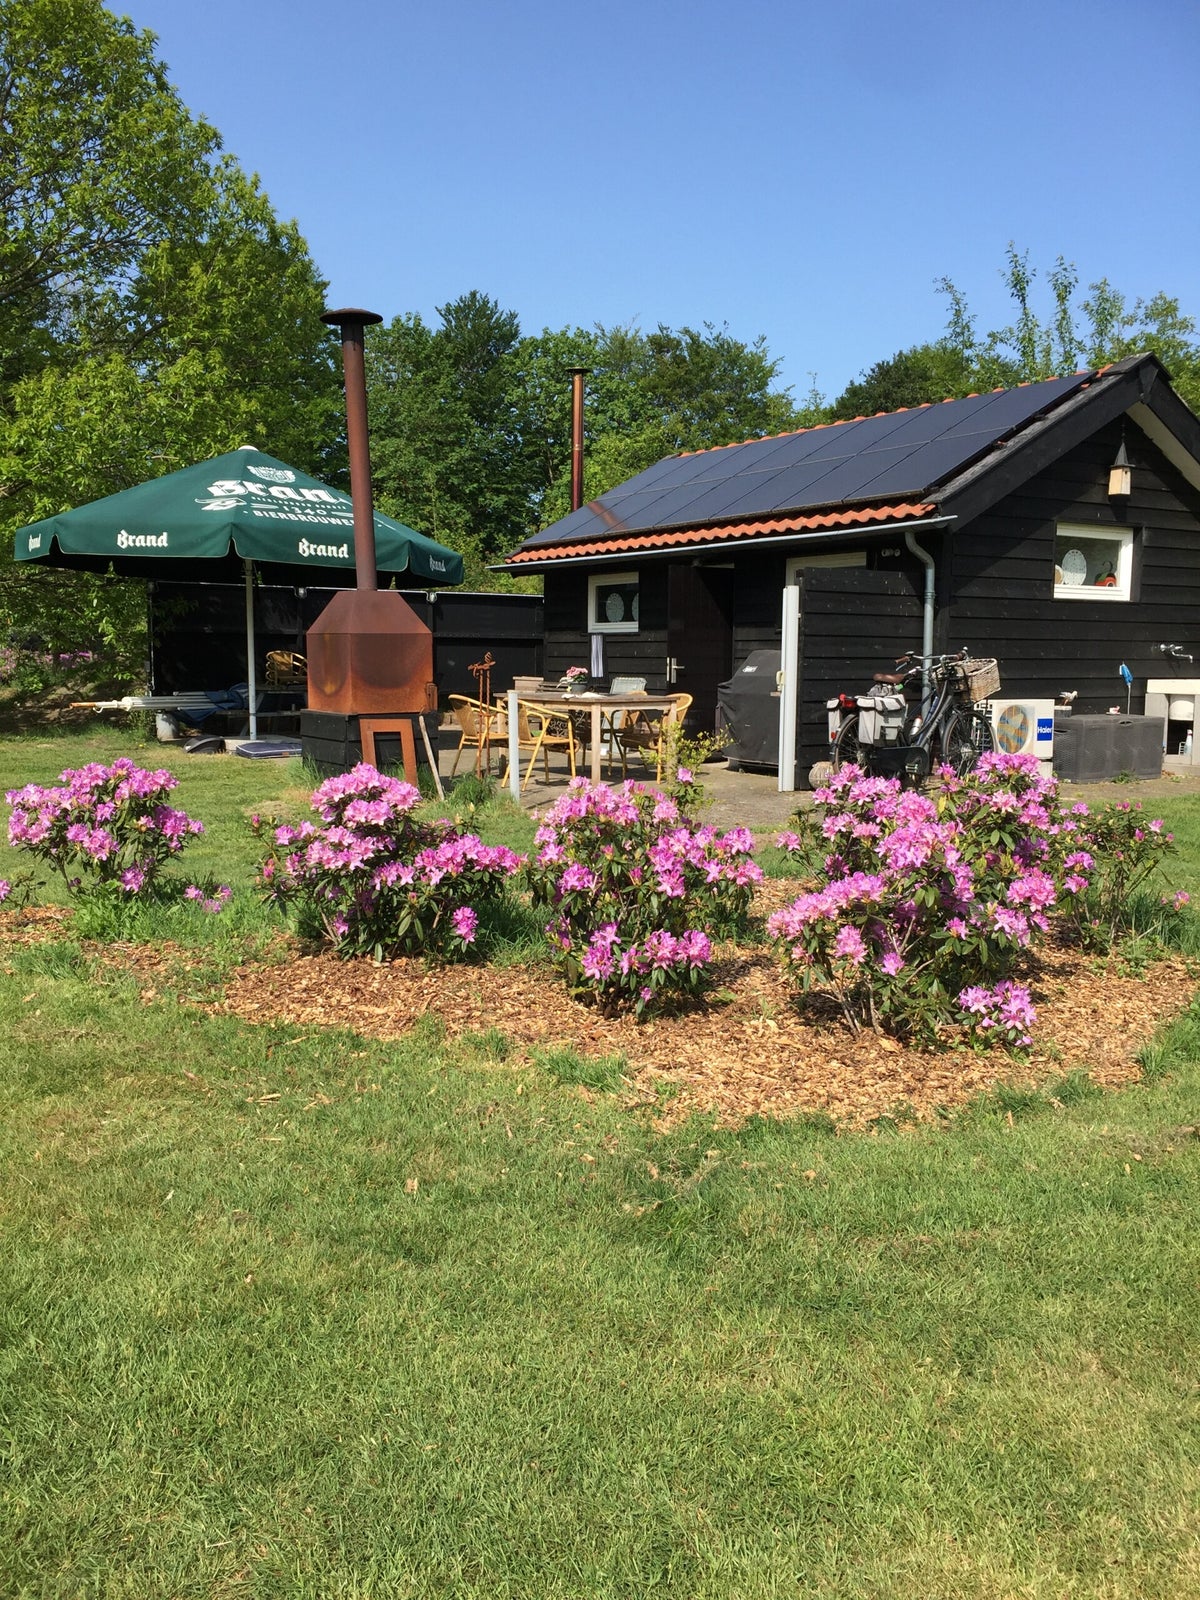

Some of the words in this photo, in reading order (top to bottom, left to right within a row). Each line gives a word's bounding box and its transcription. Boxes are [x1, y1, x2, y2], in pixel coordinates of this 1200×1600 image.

[207, 479, 352, 506] Bran
[283, 505, 328, 515] 1340
[117, 529, 169, 549] Brand
[298, 537, 350, 559] Brand
[1037, 726, 1053, 734] Haier
